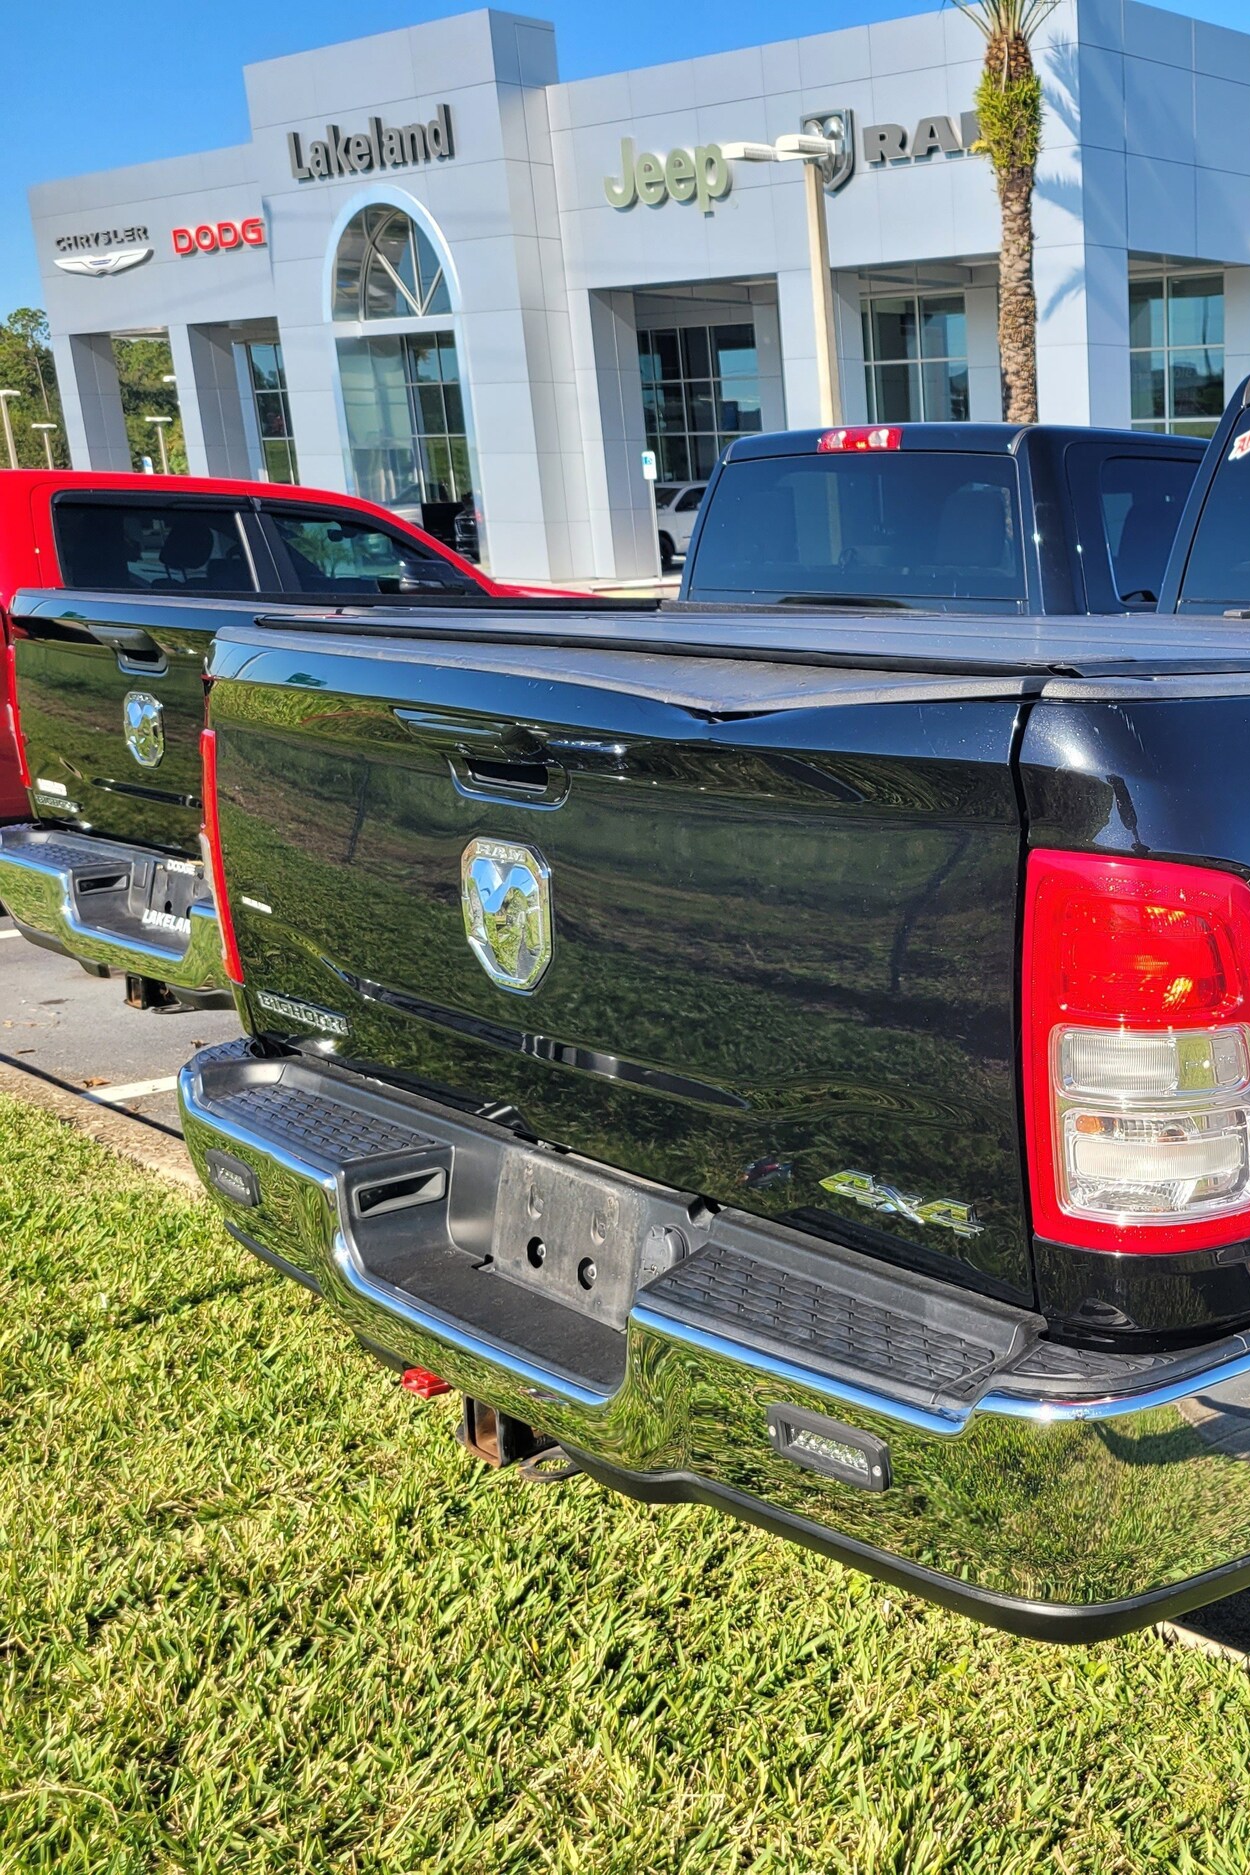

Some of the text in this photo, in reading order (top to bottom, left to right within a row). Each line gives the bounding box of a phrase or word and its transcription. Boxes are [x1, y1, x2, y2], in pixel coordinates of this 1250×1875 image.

[288, 103, 455, 183] Lakeland
[604, 137, 733, 215] Jeep
[55, 225, 149, 251] CHRYSLER
[172, 218, 266, 255] DODG
[166, 859, 196, 876] DODGE
[141, 908, 192, 935] LAKELAN
